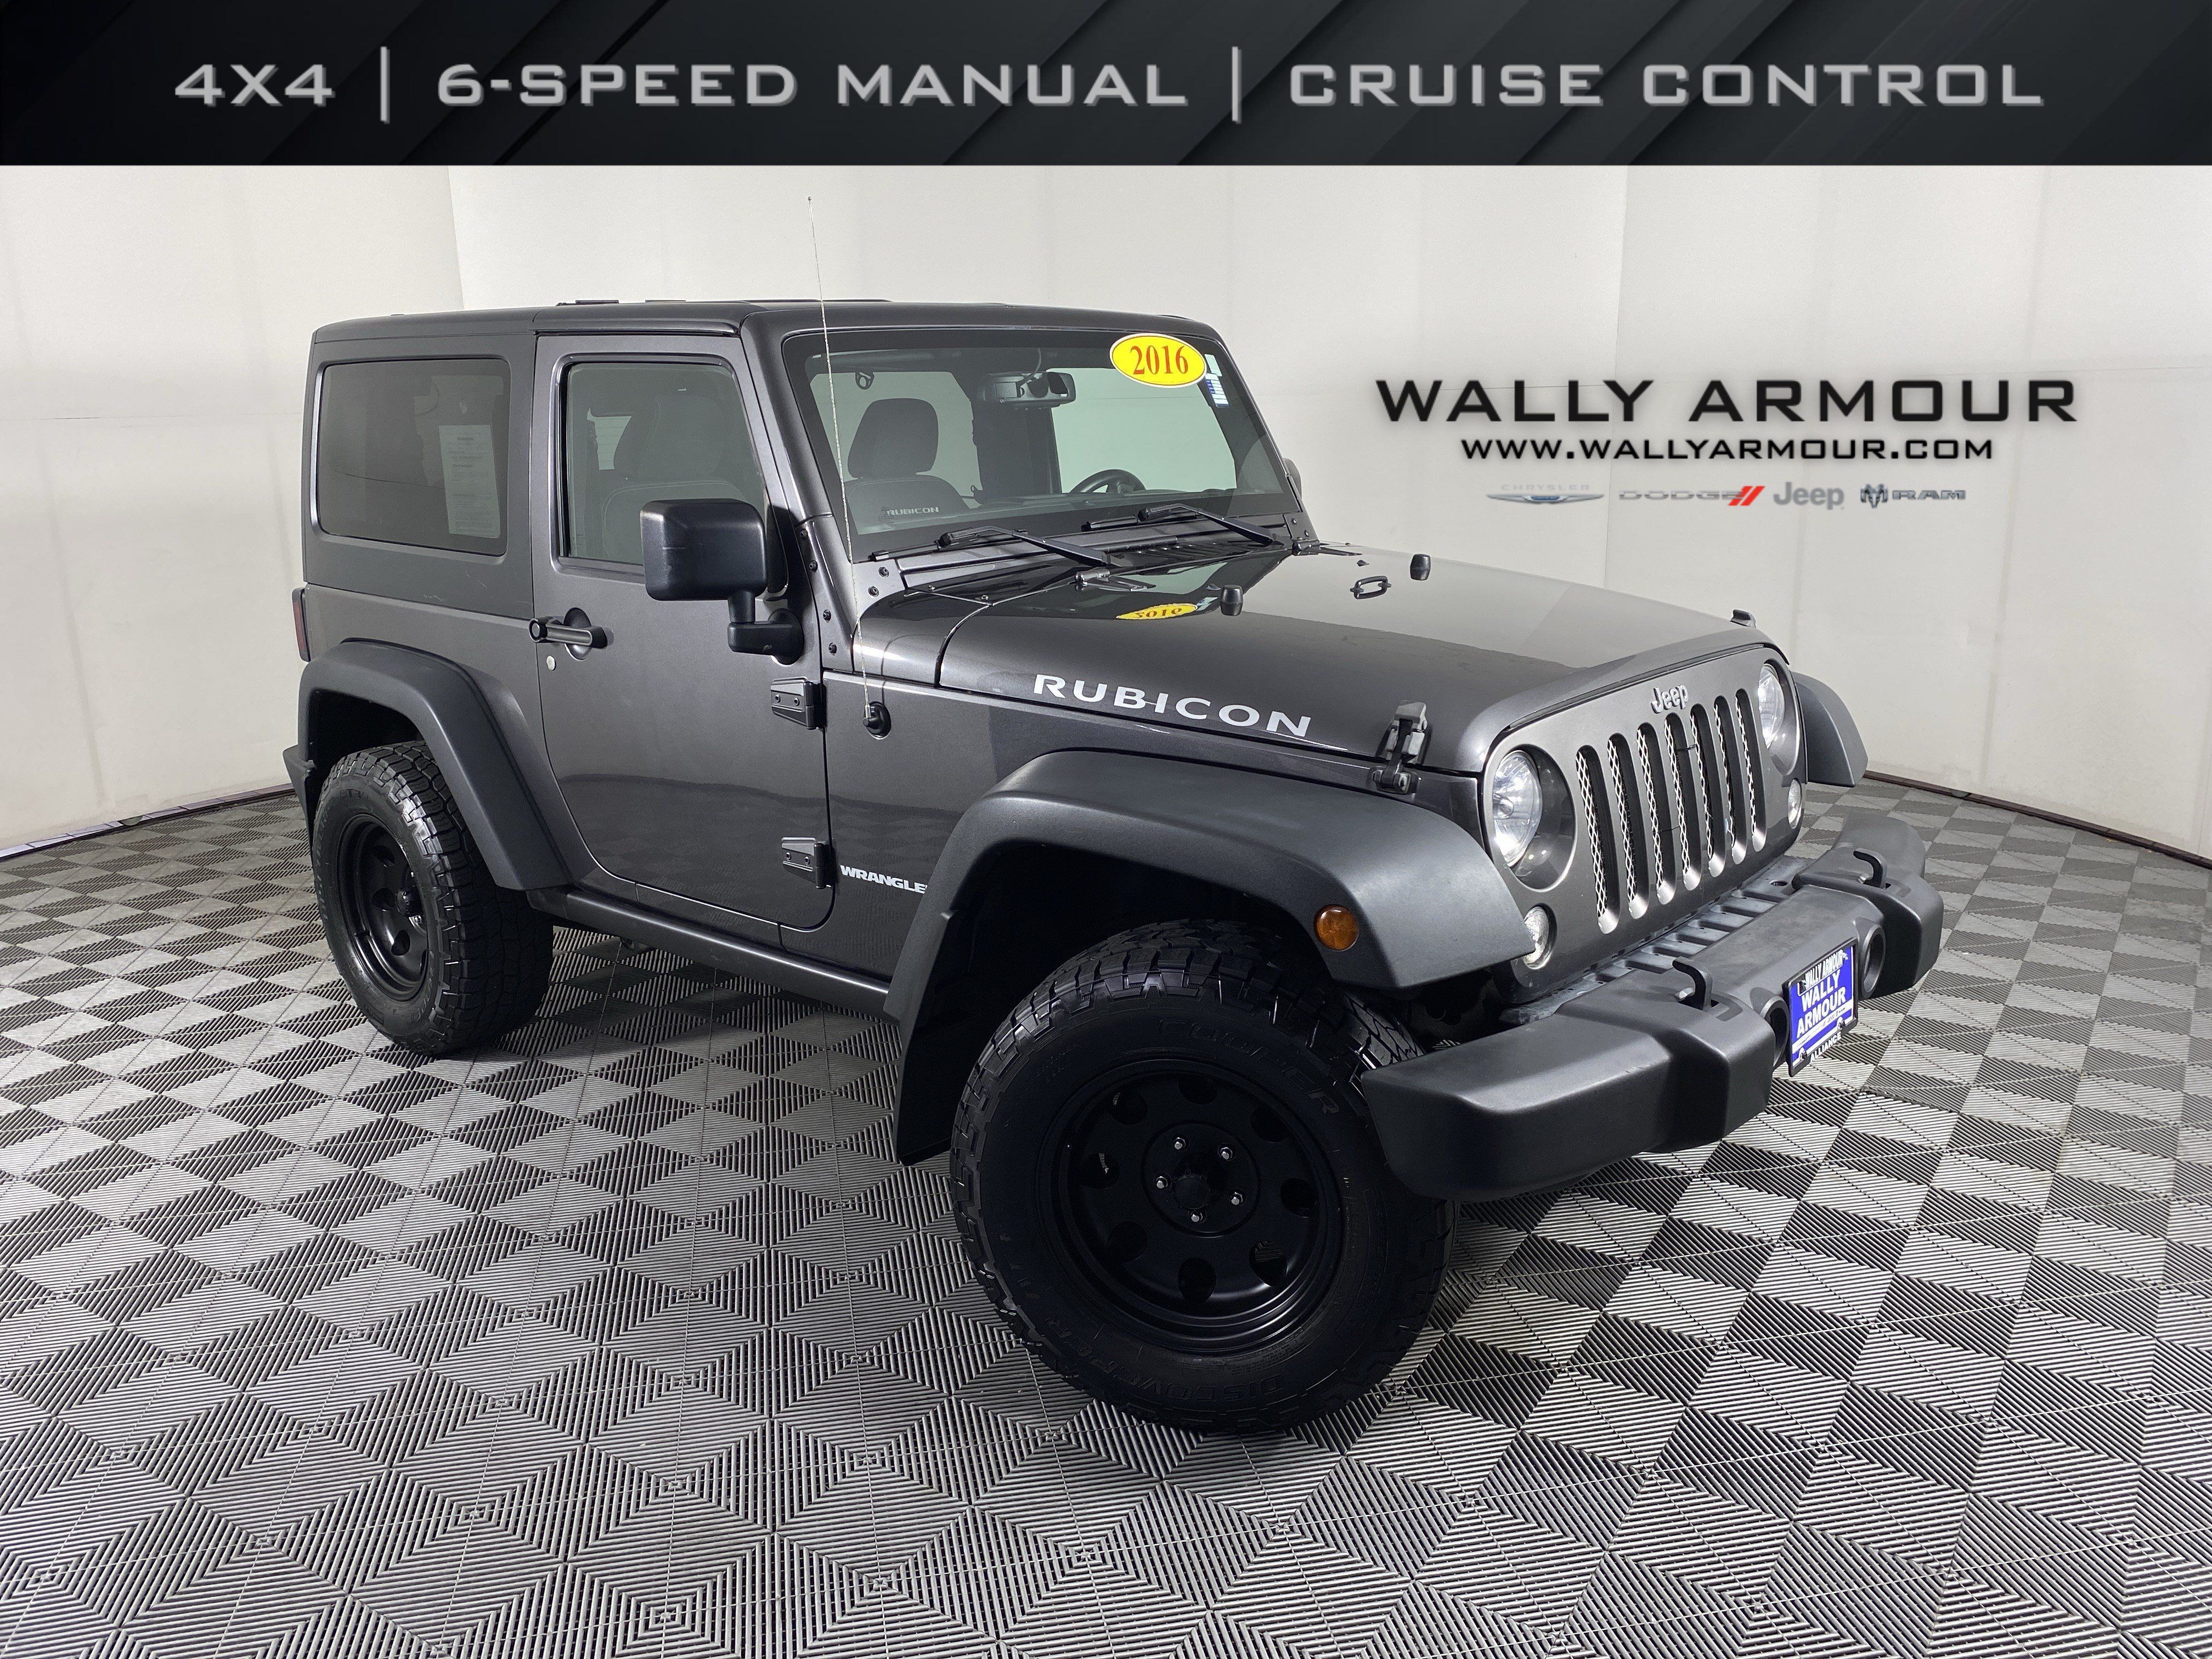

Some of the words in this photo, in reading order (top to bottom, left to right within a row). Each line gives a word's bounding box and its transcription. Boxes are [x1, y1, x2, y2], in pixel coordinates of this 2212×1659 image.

[1130, 345, 1189, 375] 2016
[887, 506, 939, 516] RUBICON
[1034, 674, 1311, 737] RUBICON
[1650, 685, 1689, 714] Jeep
[1801, 968, 1841, 1012] WALLY
[1796, 986, 1847, 1040] ARMOUR
[1810, 1031, 1842, 1064] ALLIANCE
